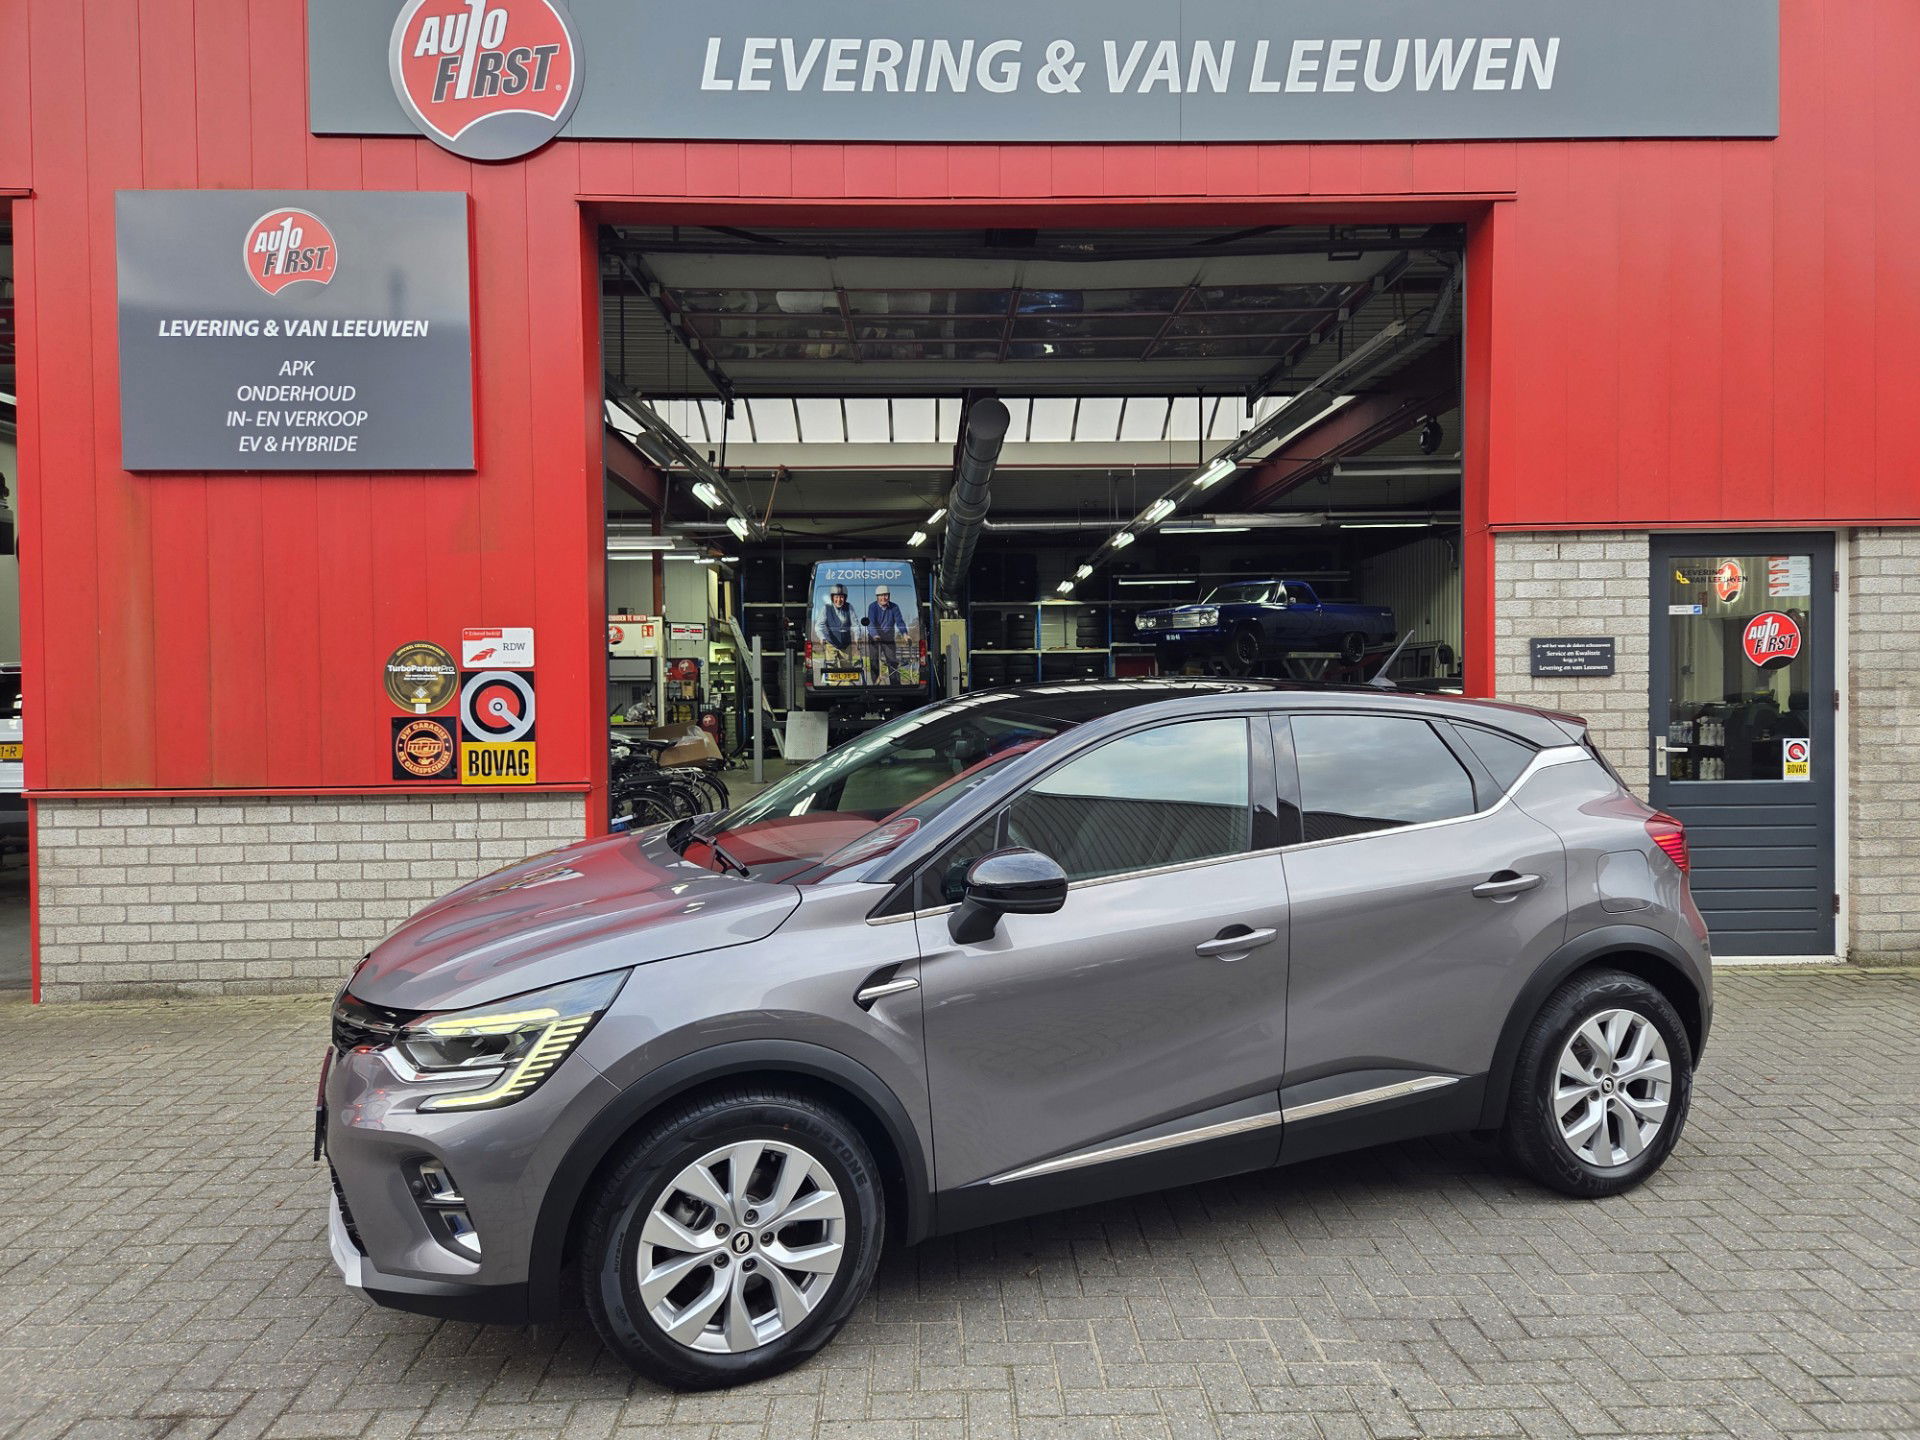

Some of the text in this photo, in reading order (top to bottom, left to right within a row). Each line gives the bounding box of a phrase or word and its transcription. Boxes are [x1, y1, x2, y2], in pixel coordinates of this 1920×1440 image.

[431, 44, 560, 103] FIRST
[700, 37, 1560, 94] LEVERING & VAN LEEUWEN
[253, 216, 303, 253] AUTO
[263, 246, 329, 277] FIRST
[158, 319, 429, 337] LEVERING & VAN LEEUWEN
[279, 360, 316, 377] APK
[237, 385, 356, 401] ONDERHOUD
[226, 410, 368, 427] IN- EN VERKOOP
[239, 435, 358, 452] EV & HYBRIDE
[837, 569, 902, 579] ZORGSHOP
[1748, 616, 1780, 640] AUTO
[502, 642, 526, 651] RDW
[1754, 633, 1797, 655] FIRST
[468, 749, 530, 777] BOVAG
[1786, 764, 1807, 774] BOVAG
